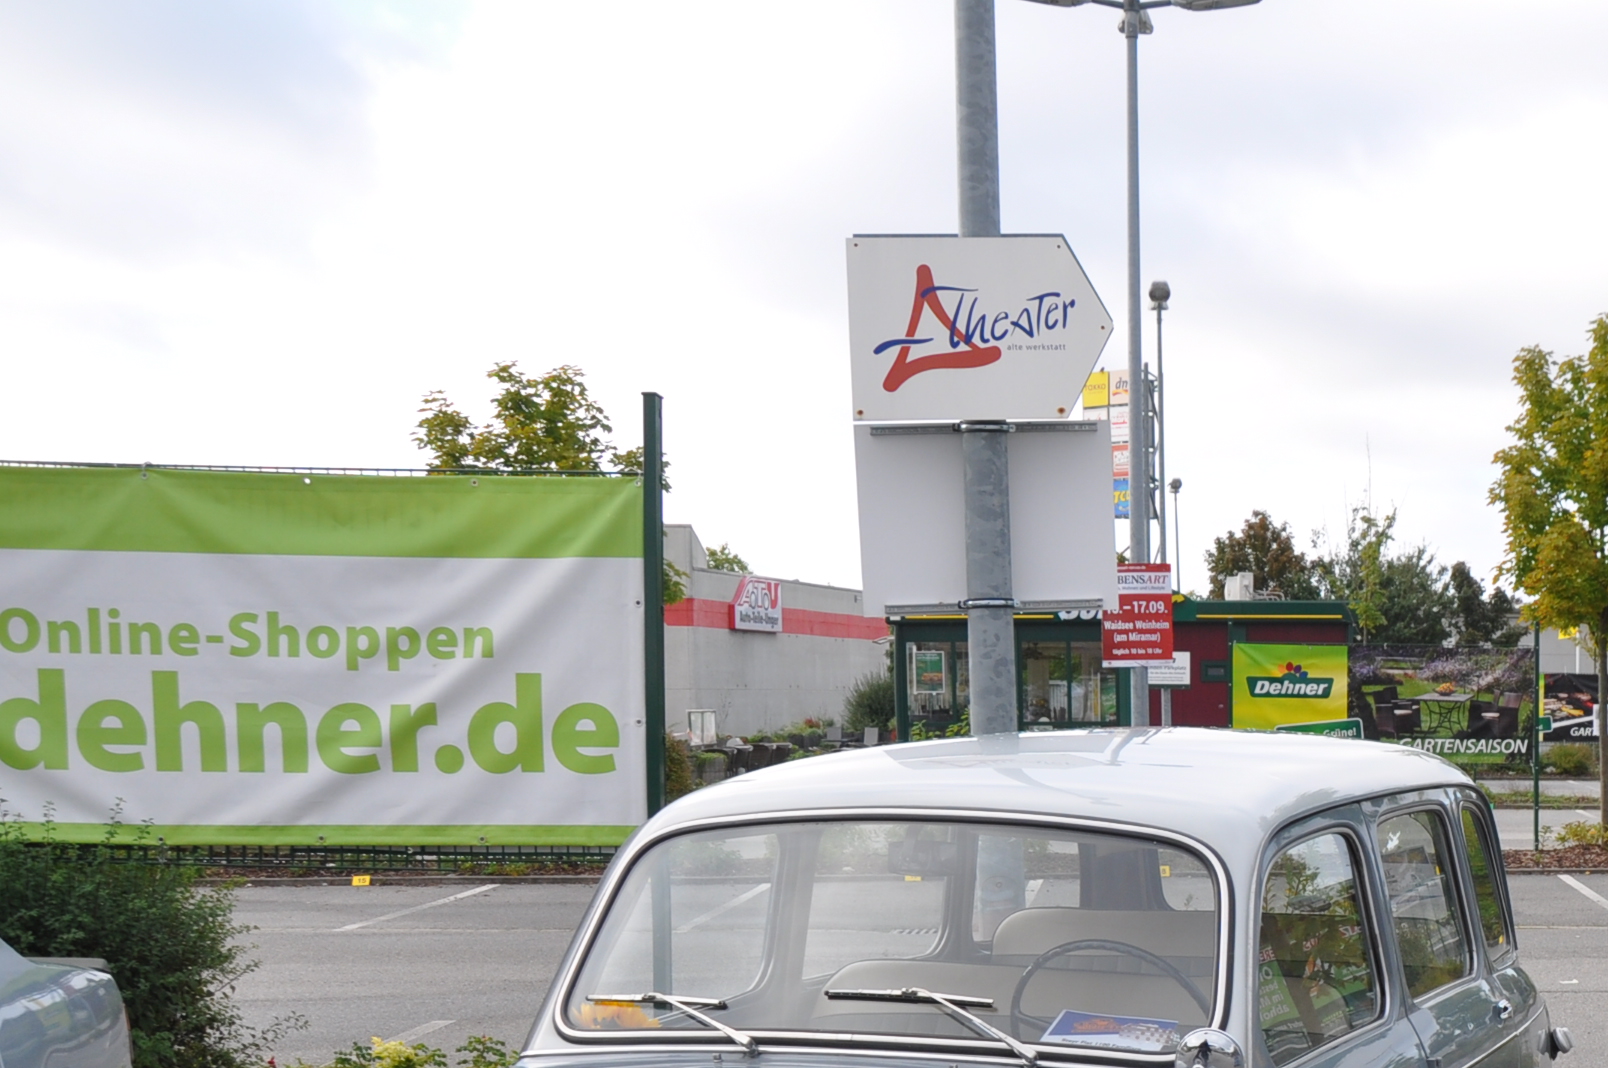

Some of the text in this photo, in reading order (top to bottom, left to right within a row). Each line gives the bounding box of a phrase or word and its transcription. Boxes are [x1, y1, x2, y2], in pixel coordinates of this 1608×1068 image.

[1006, 343, 1066, 351] alte werkstatt
[1117, 575, 1168, 585] BENSART
[1104, 620, 1169, 629] Waidsee Weinheim
[0, 607, 494, 671] Online-Shoppen
[1114, 632, 1127, 643] (am
[1254, 680, 1328, 696] Dehner
[0, 668, 620, 775] dehner.de
[1400, 738, 1528, 754] GARTENSAISON
